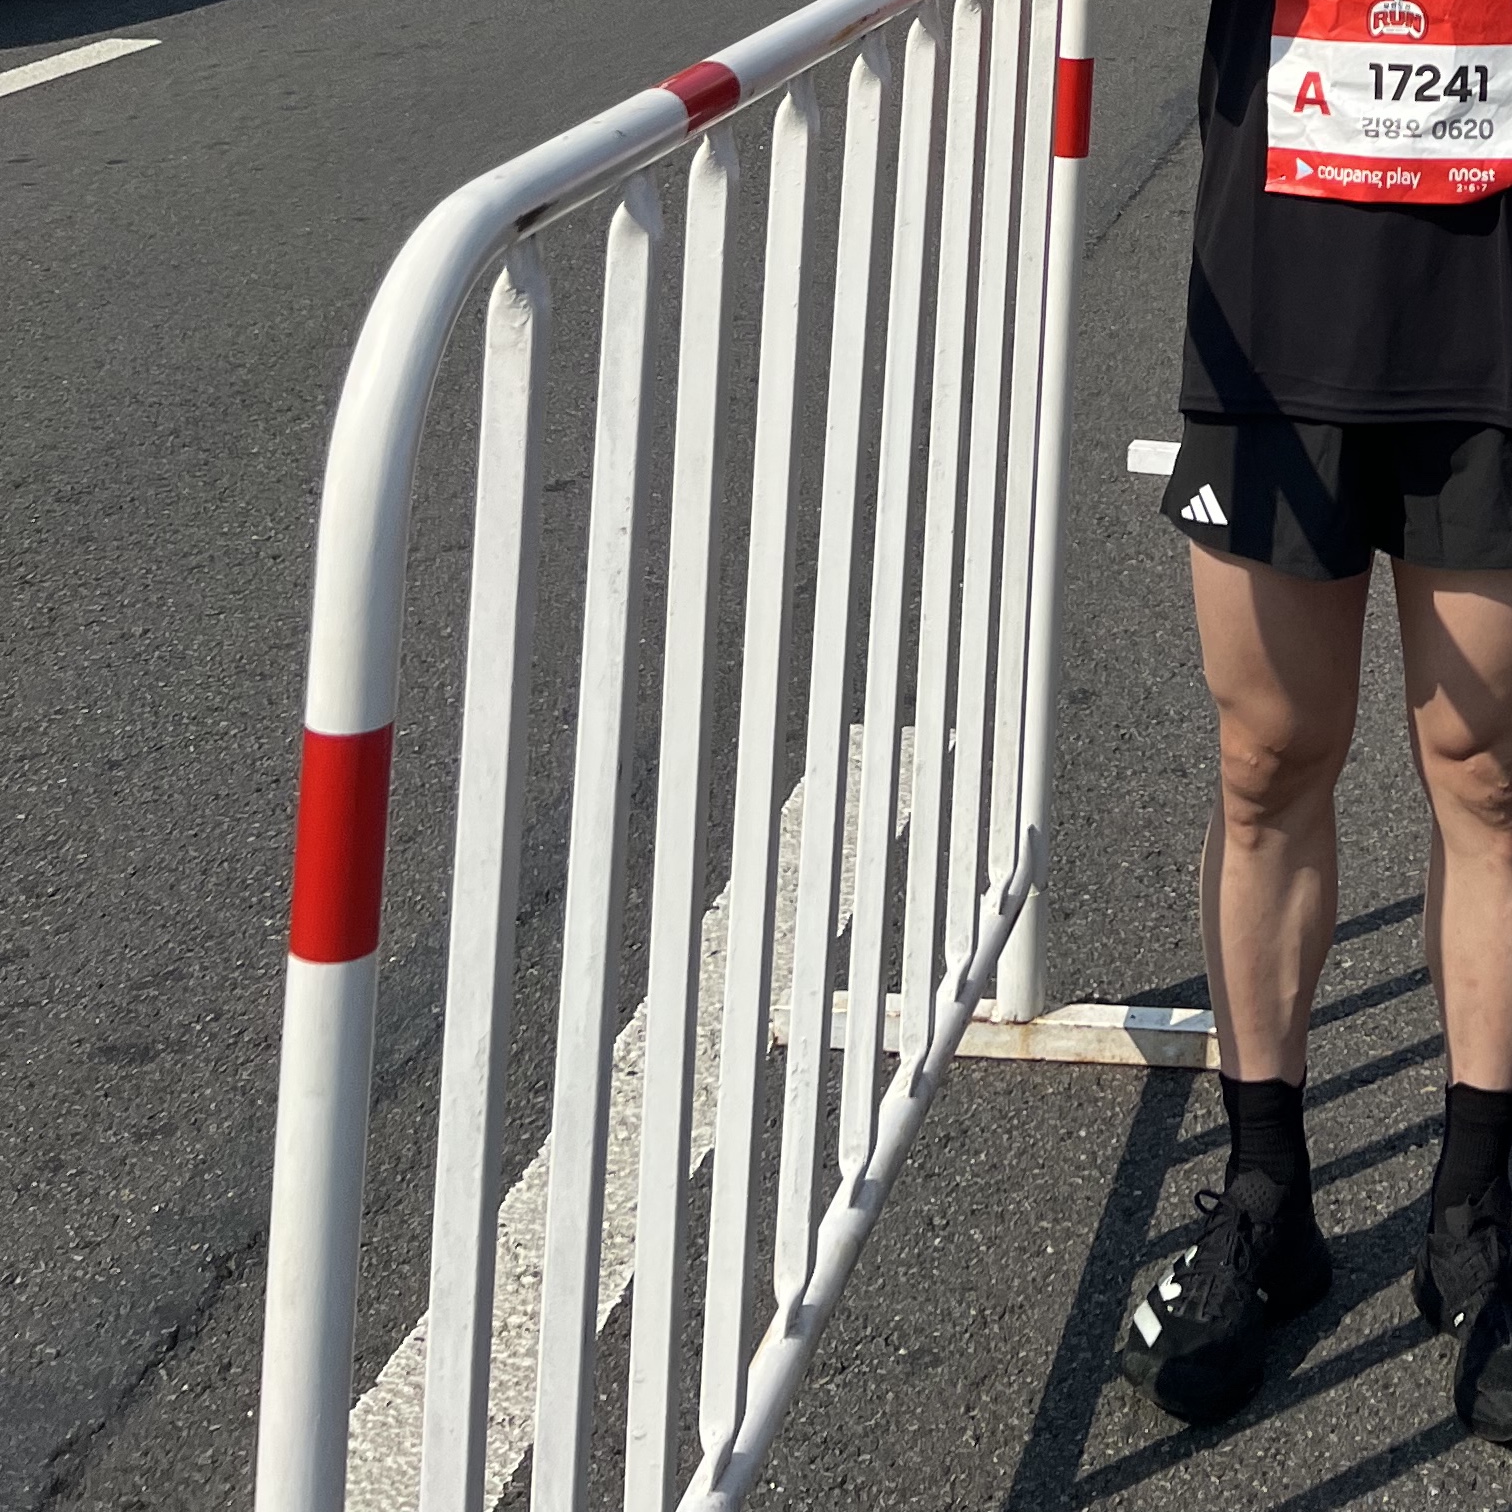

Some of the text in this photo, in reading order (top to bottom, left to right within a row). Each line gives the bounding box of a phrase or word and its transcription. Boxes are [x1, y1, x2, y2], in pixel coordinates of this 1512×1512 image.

[1373, 10, 1422, 33] RUN
[1293, 71, 1331, 116] A
[1369, 62, 1488, 103] 17241
[1361, 117, 1495, 140] 김영오 0620
[1317, 165, 1421, 189] coupang play
